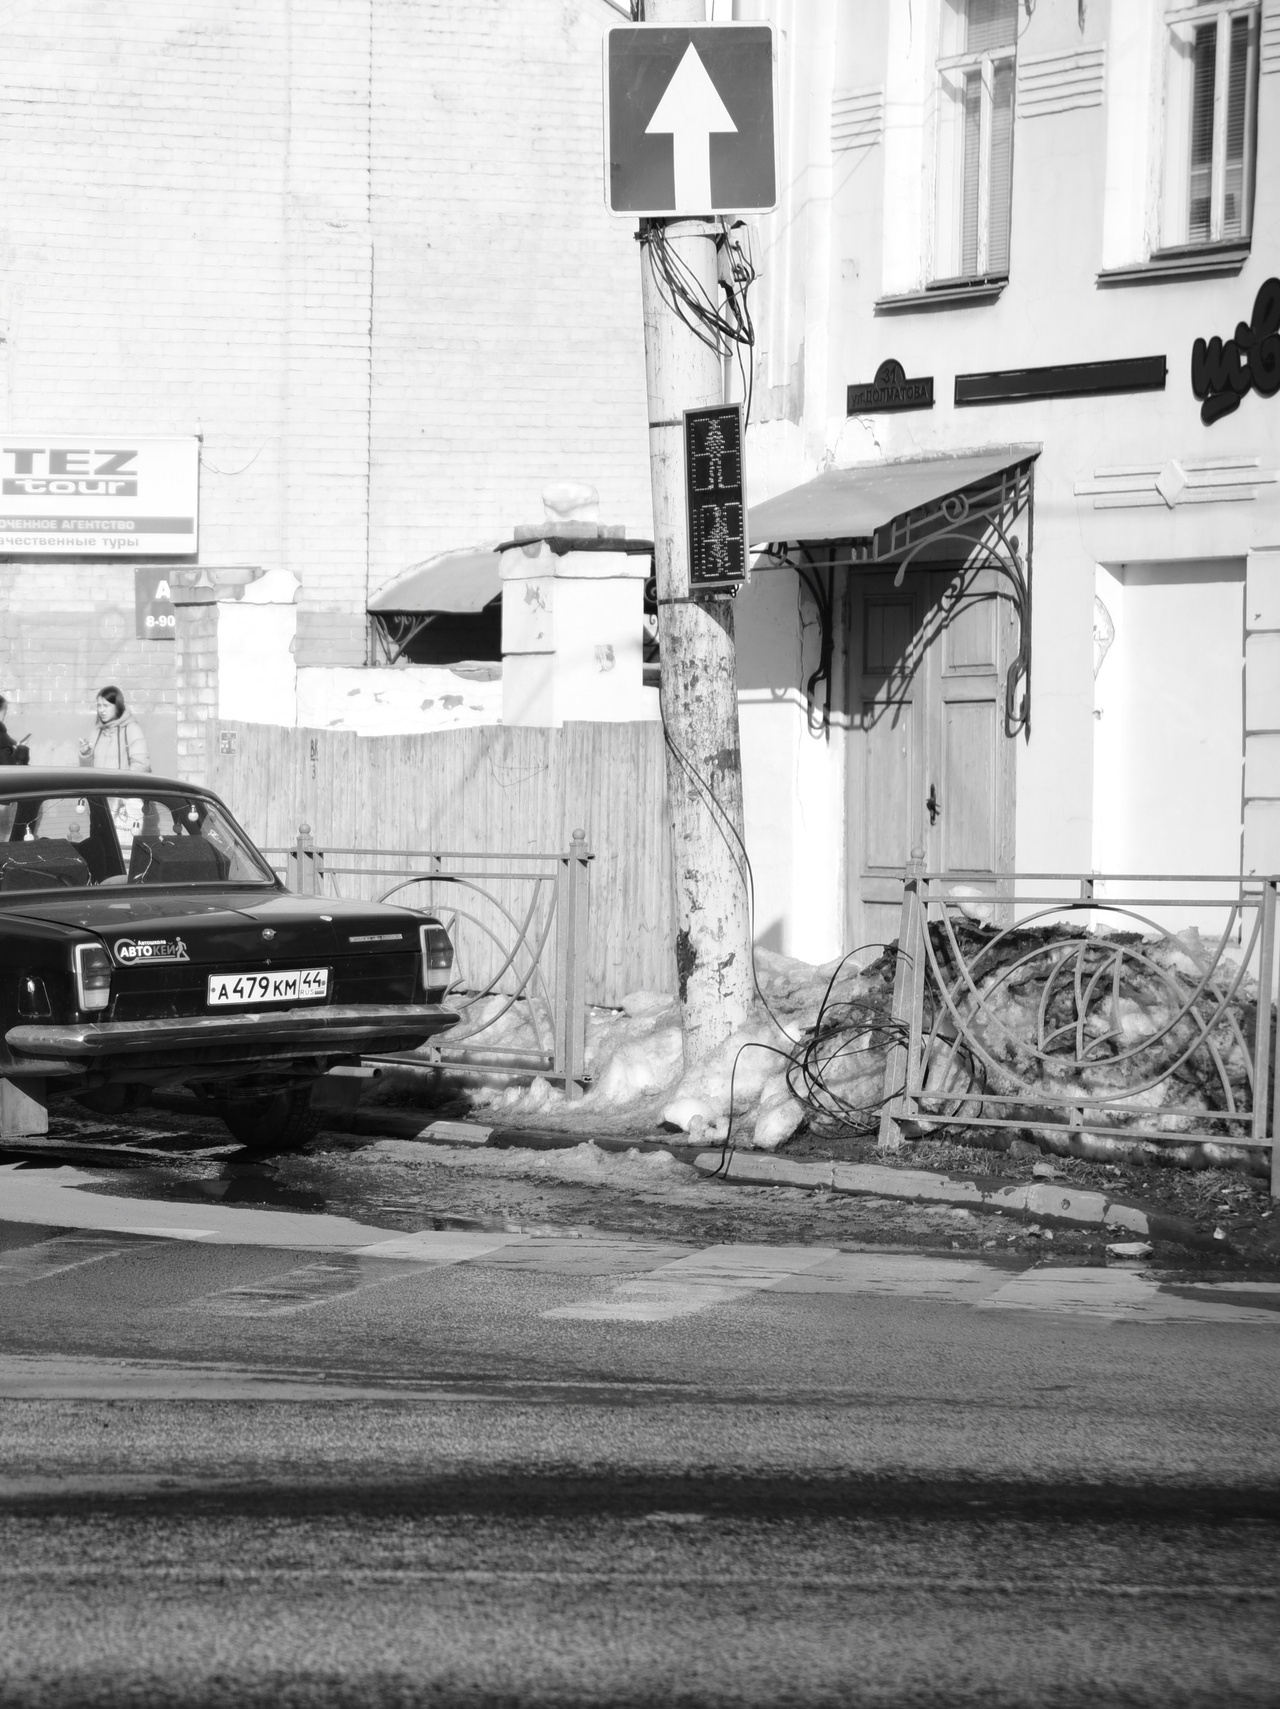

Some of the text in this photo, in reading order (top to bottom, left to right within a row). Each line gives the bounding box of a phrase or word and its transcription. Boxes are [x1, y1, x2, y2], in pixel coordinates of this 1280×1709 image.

[880, 364, 896, 384] 31
[865, 384, 928, 405] ДОЛМАТОВА
[3, 448, 138, 476] TEZ
[15, 479, 126, 494] tour
[61, 520, 135, 530] АГЕНТСТВО
[102, 538, 139, 549] туры
[120, 942, 176, 958] АВТОКЕЙ
[303, 971, 321, 988] 44
[300, 988, 314, 996] RUS
